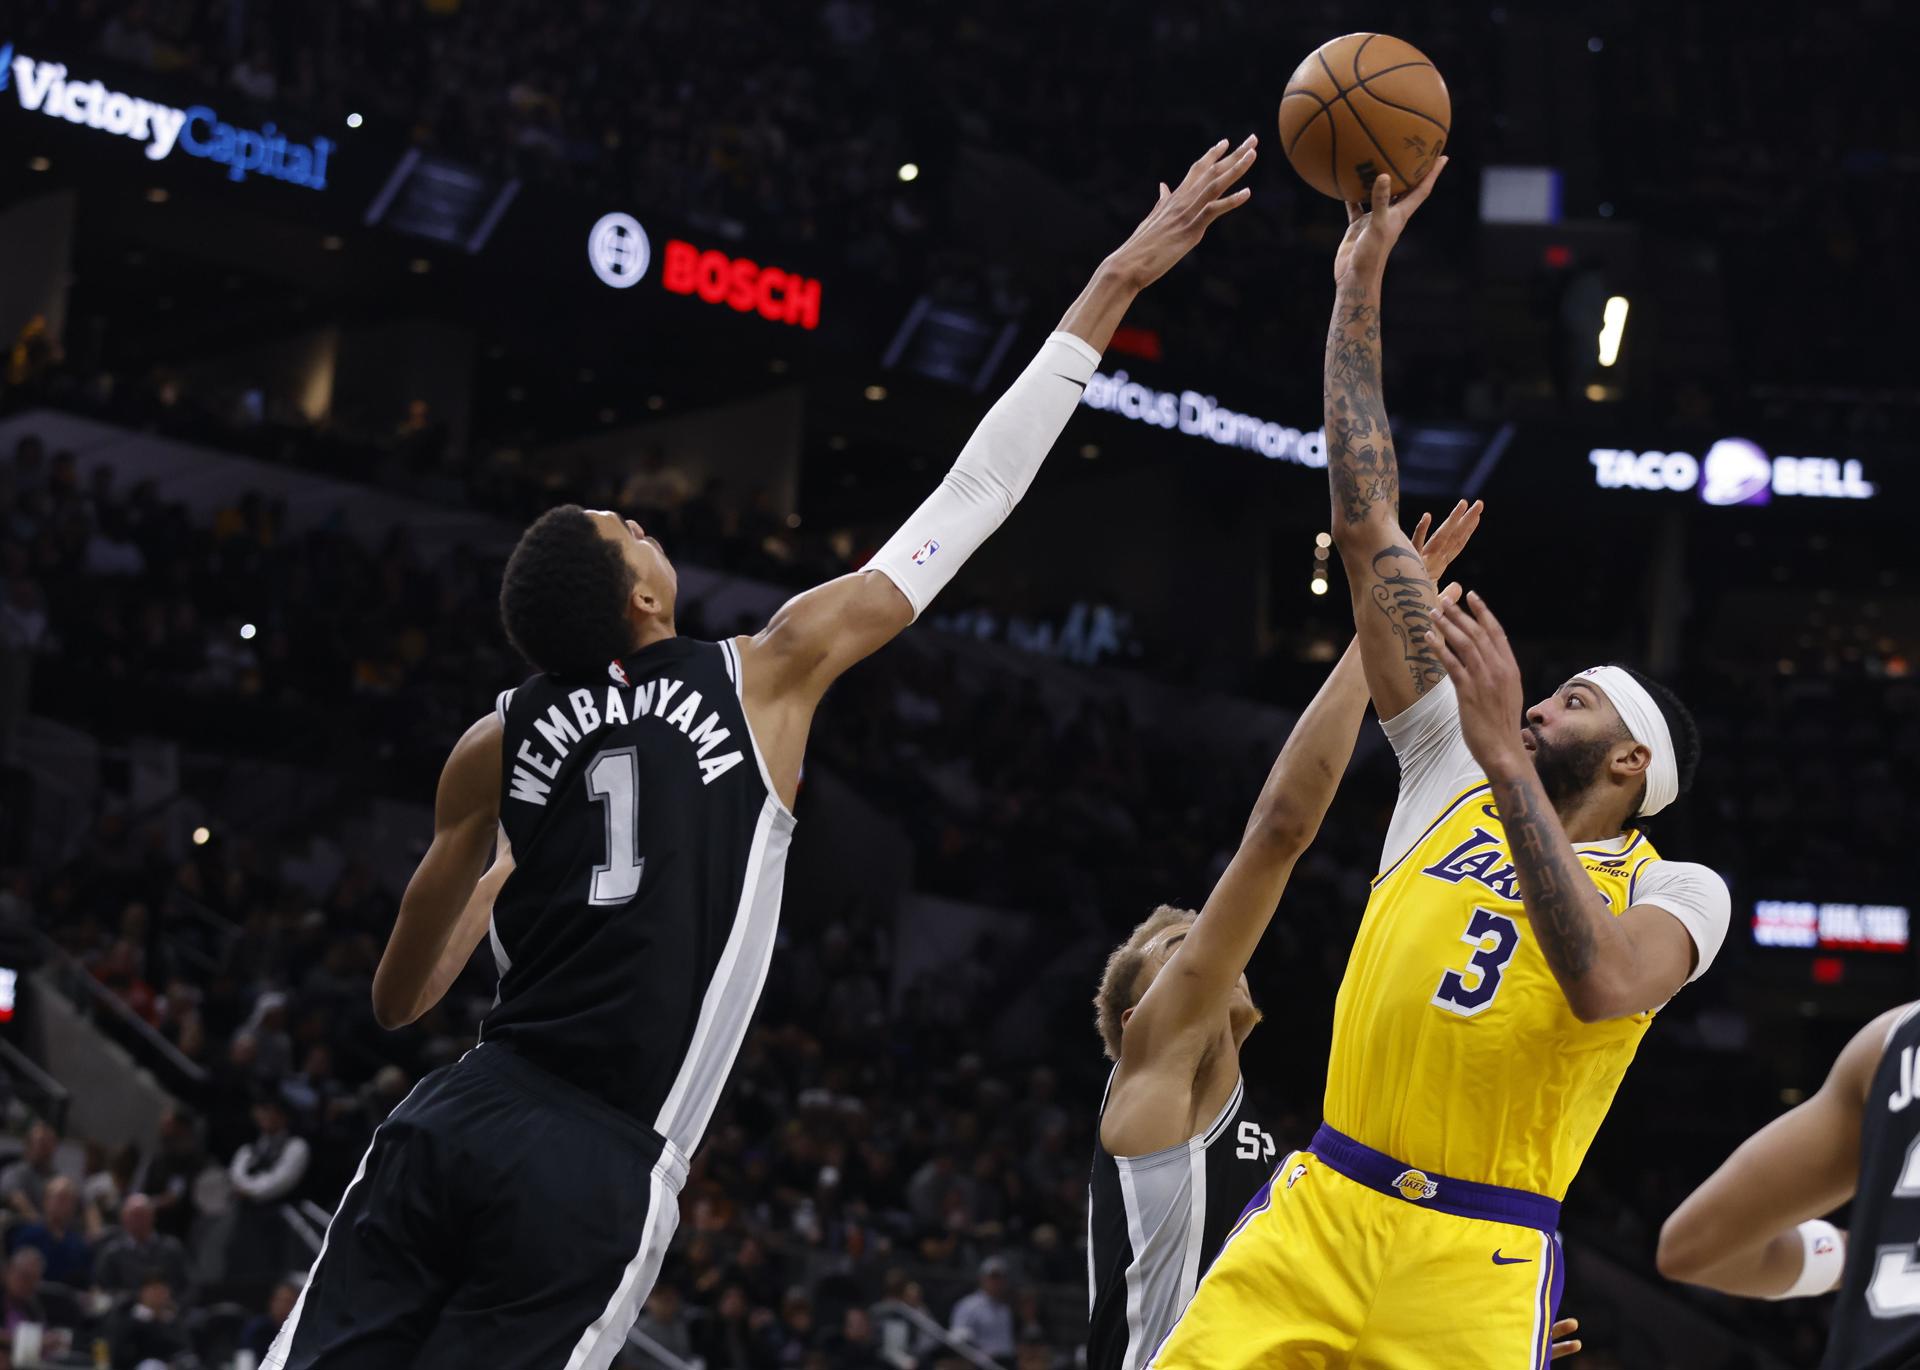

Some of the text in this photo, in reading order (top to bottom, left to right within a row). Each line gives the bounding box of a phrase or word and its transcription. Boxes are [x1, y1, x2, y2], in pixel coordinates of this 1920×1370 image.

[11, 54, 332, 190] VictoryCapital
[663, 239, 822, 330] BOSCH
[1589, 448, 1874, 499] TACO BELL
[509, 677, 745, 807] WEMBANYAMA
[584, 745, 645, 906] 1
[1585, 864, 1630, 878] bibigo
[1430, 904, 1521, 1008] 3
